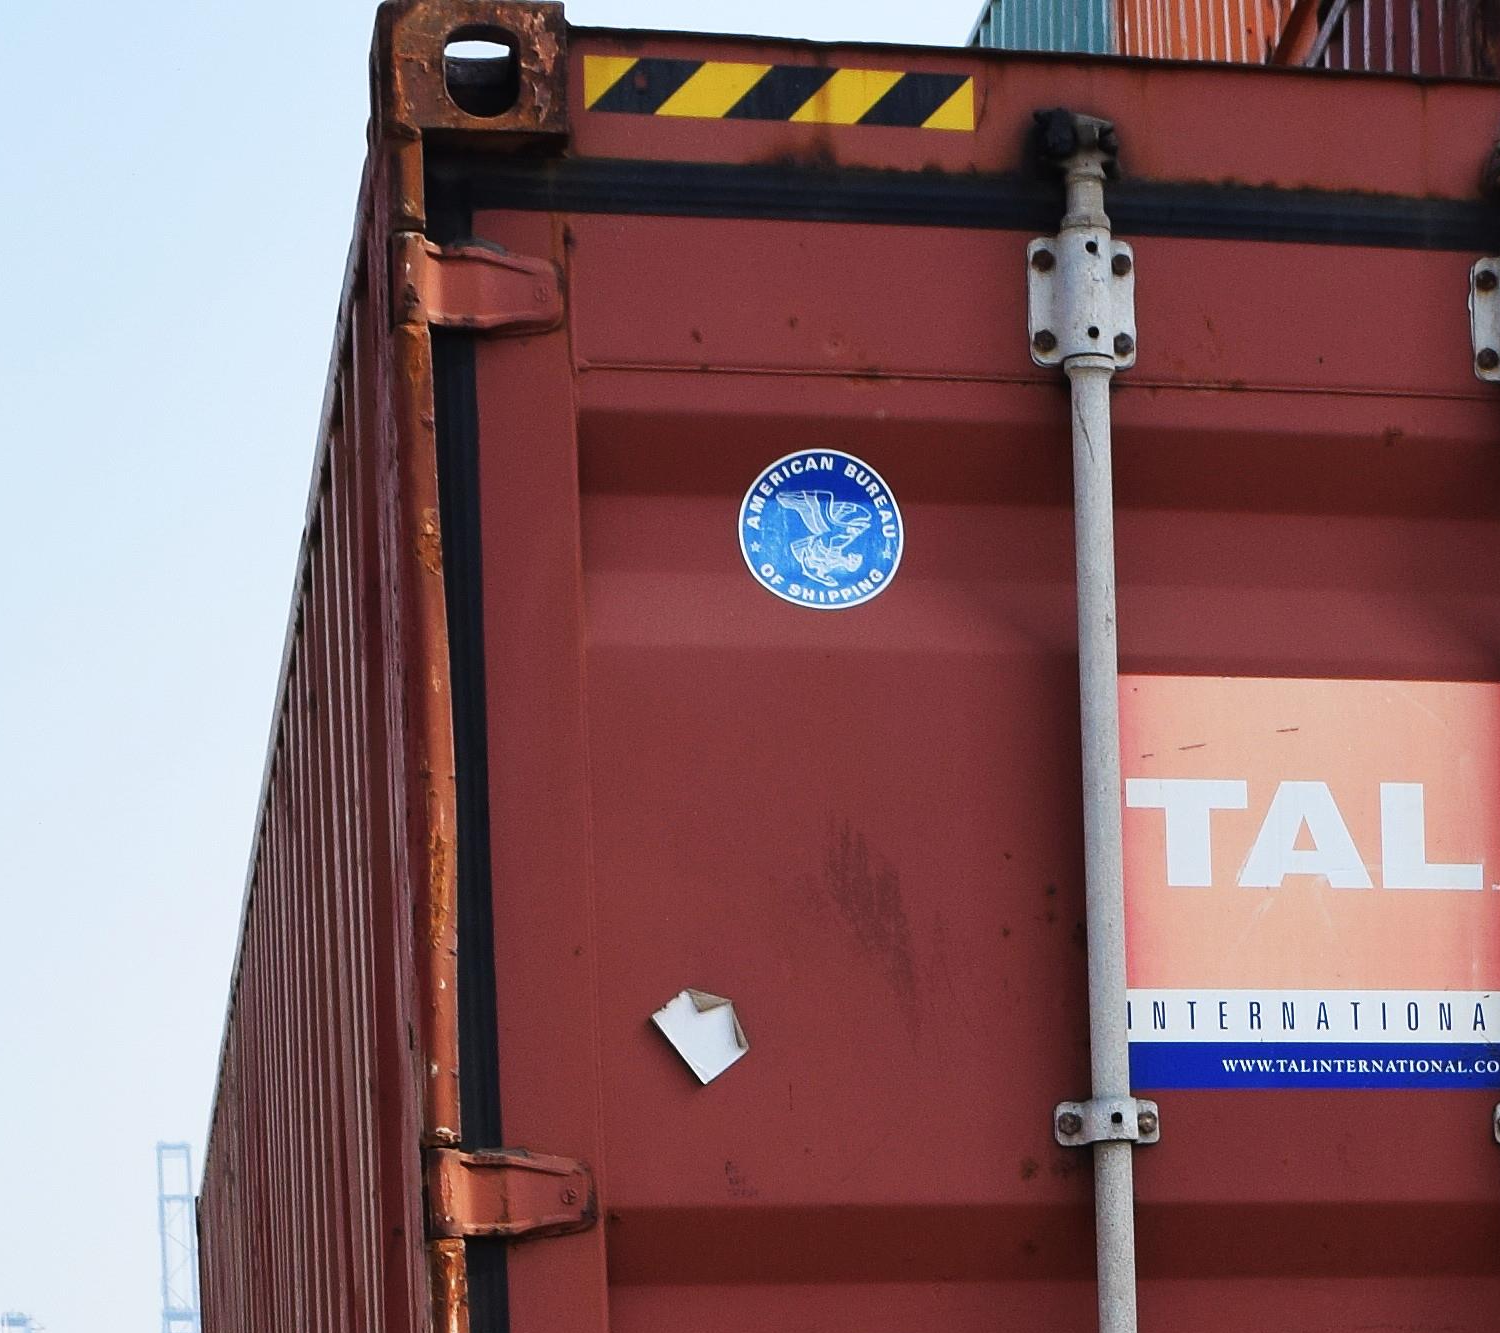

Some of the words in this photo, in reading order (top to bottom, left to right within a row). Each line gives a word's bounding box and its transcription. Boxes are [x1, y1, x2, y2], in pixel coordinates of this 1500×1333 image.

[746, 455, 835, 531] AMERICAN
[844, 462, 897, 539] BUREAU
[760, 563, 785, 587] OF
[788, 567, 886, 604] SHIPPING
[1124, 777, 1484, 891] TAL
